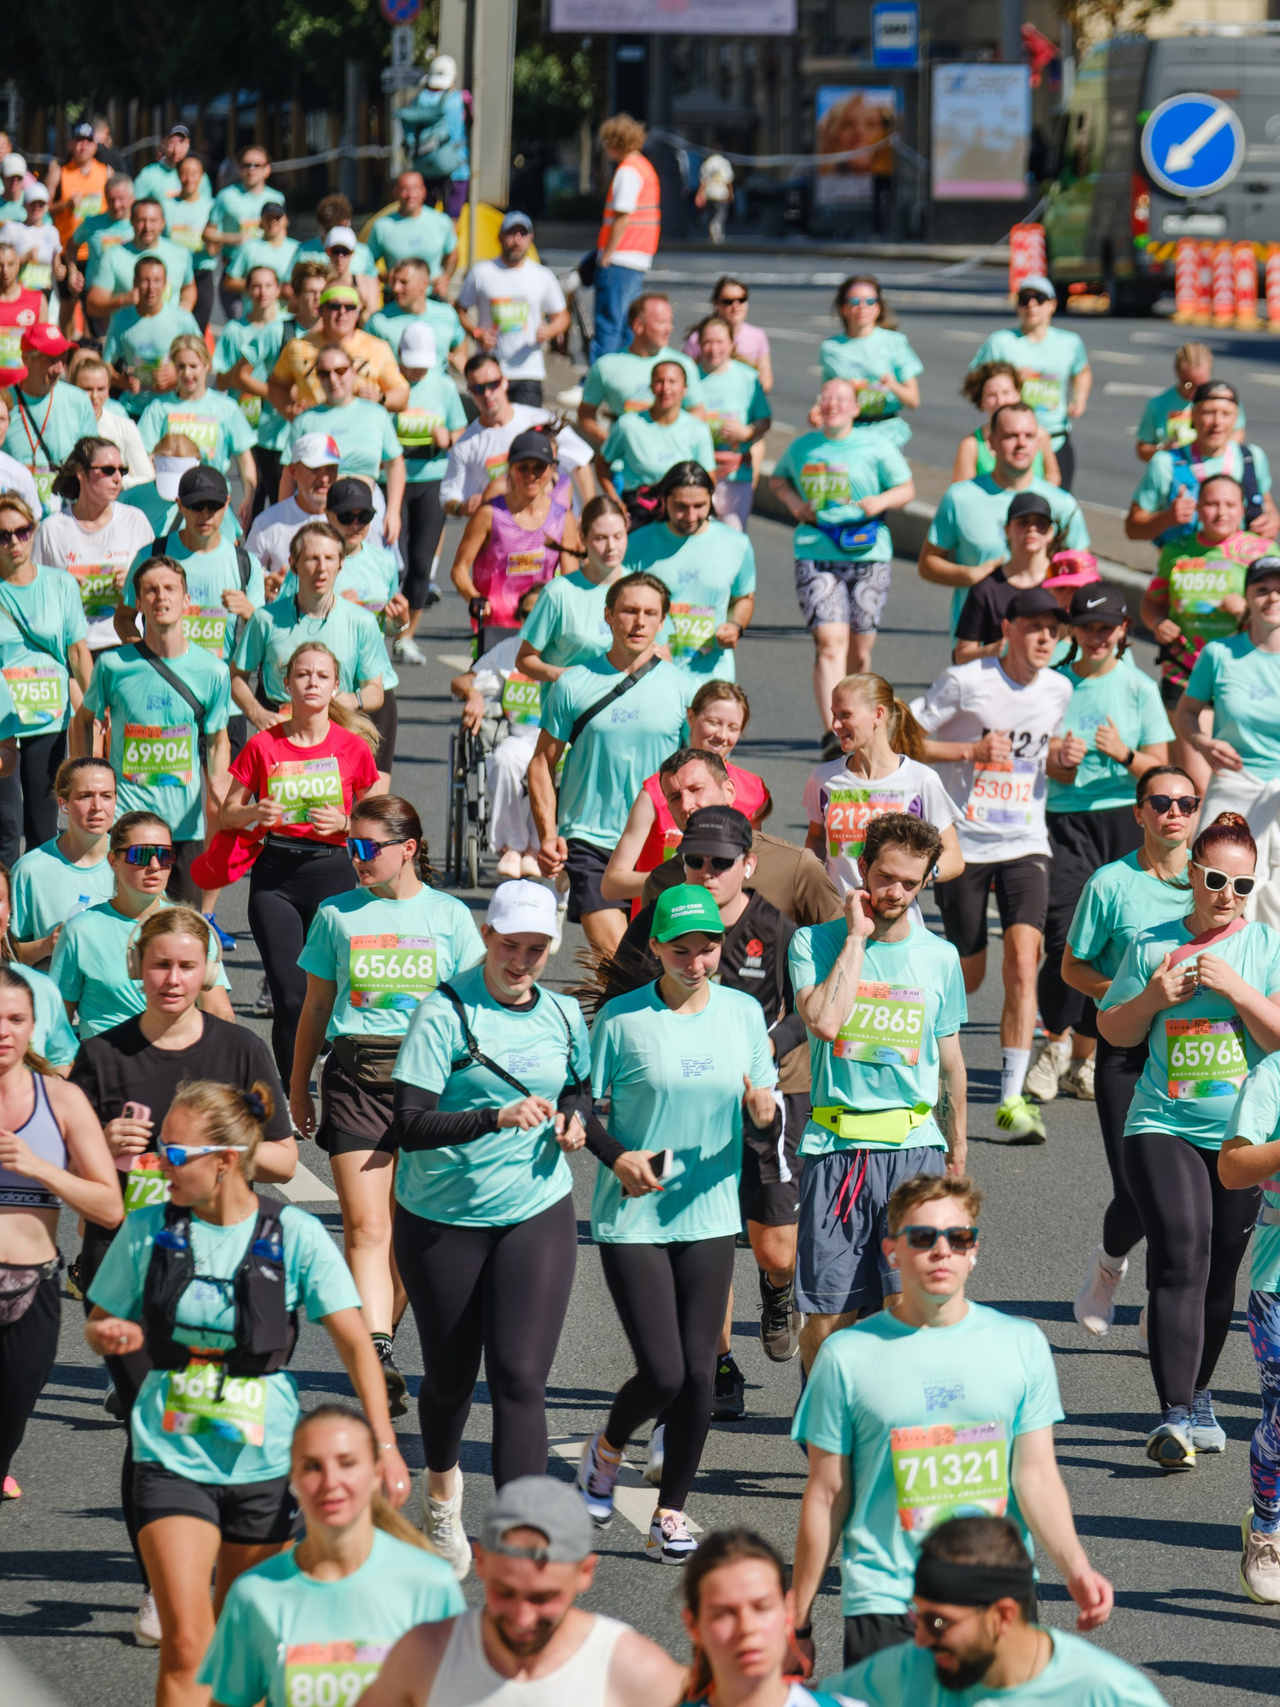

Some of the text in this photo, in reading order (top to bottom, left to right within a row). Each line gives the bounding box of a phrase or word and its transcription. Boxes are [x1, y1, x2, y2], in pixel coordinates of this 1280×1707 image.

[126, 741, 190, 762] 69904
[271, 776, 339, 803] 70202
[973, 778, 1031, 802] 53012
[354, 954, 434, 979] 65668
[1170, 1037, 1244, 1066] 65965
[898, 1449, 999, 1491] 71321
